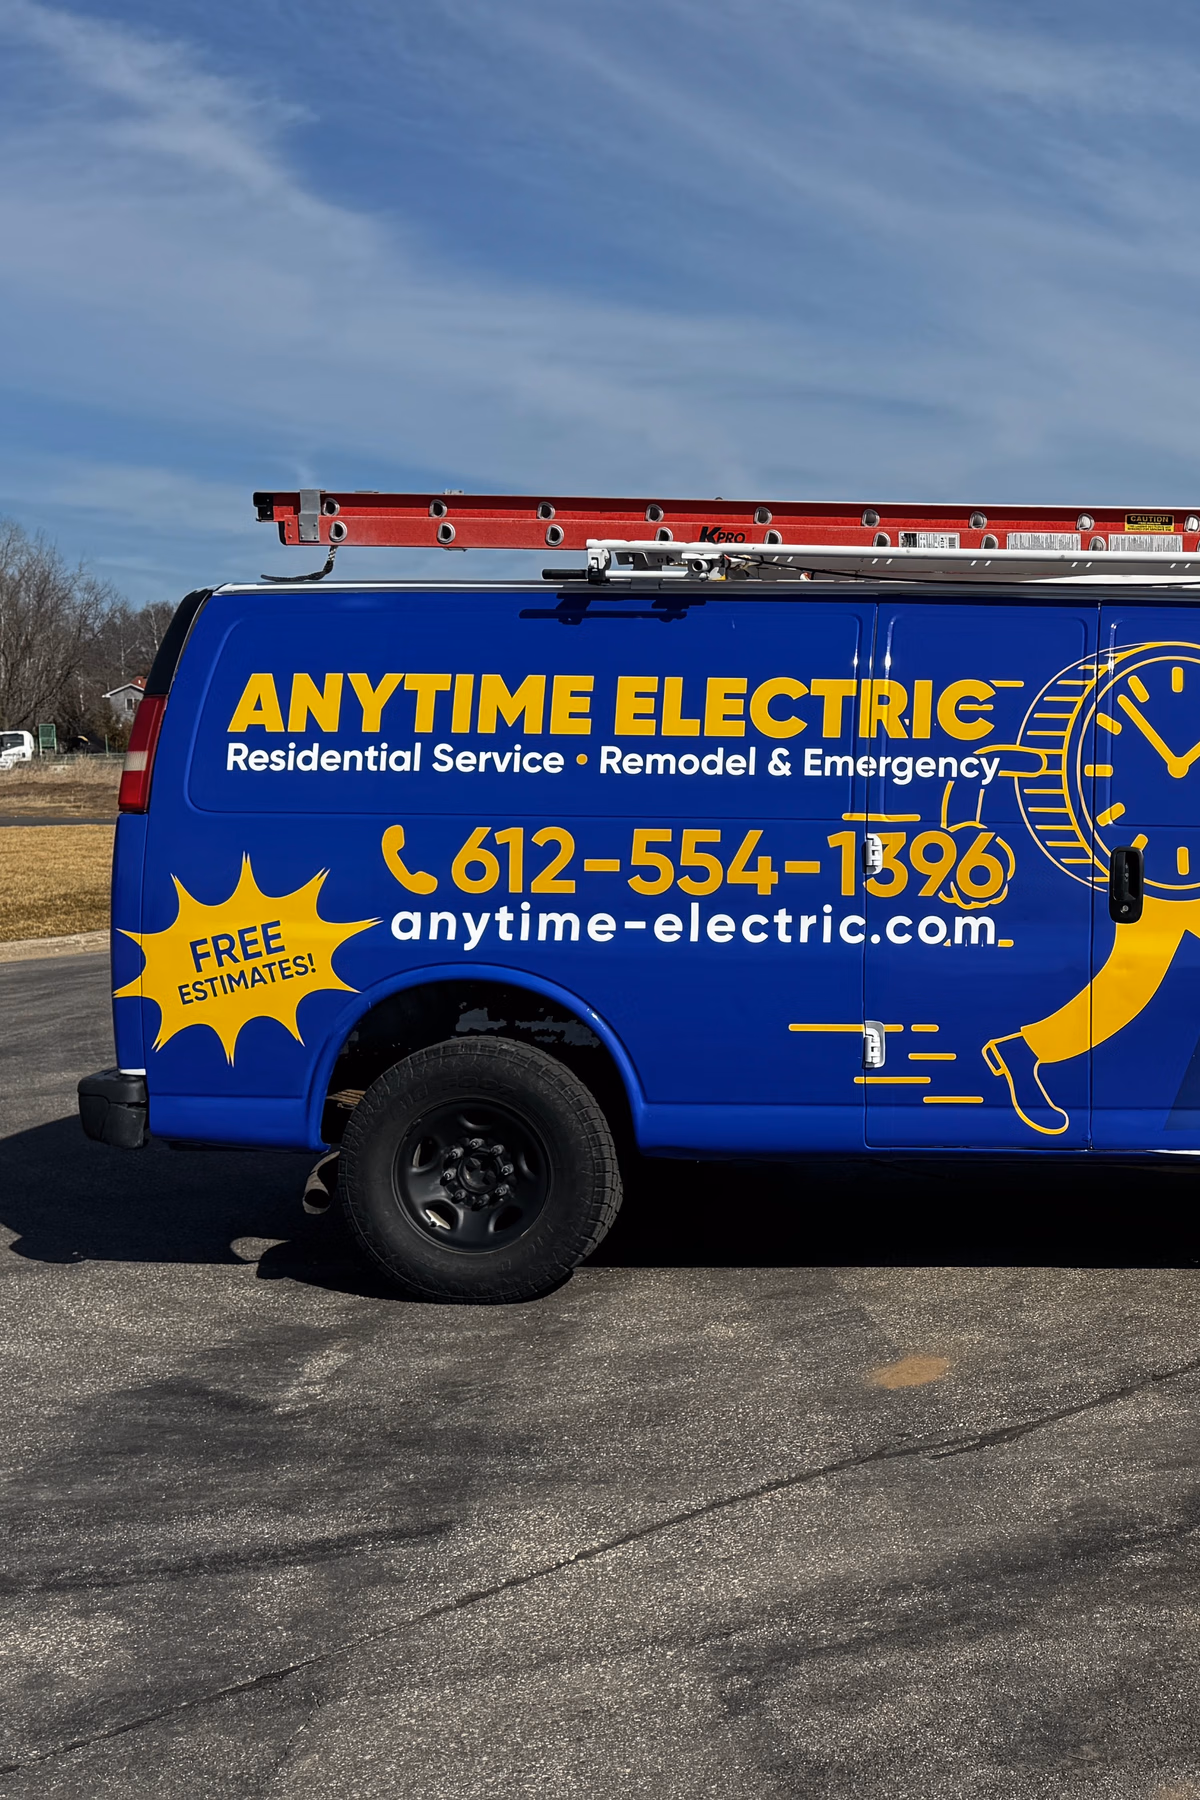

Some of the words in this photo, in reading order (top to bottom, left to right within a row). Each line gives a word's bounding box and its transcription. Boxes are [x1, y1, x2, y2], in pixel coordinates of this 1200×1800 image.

[1130, 515, 1169, 523] CAUTION
[227, 672, 592, 735] ANYTIME
[615, 677, 996, 740] ELECTRIC
[226, 742, 421, 772] Residential
[431, 743, 565, 774] Service
[600, 746, 756, 776] Remodel
[767, 747, 792, 776] &
[804, 748, 1001, 785] Emergency
[451, 826, 1005, 899] 612-554-1396
[189, 920, 286, 973] FREE
[391, 901, 997, 951] anytime-electric.com
[178, 952, 316, 1005] ESTIMATES!
